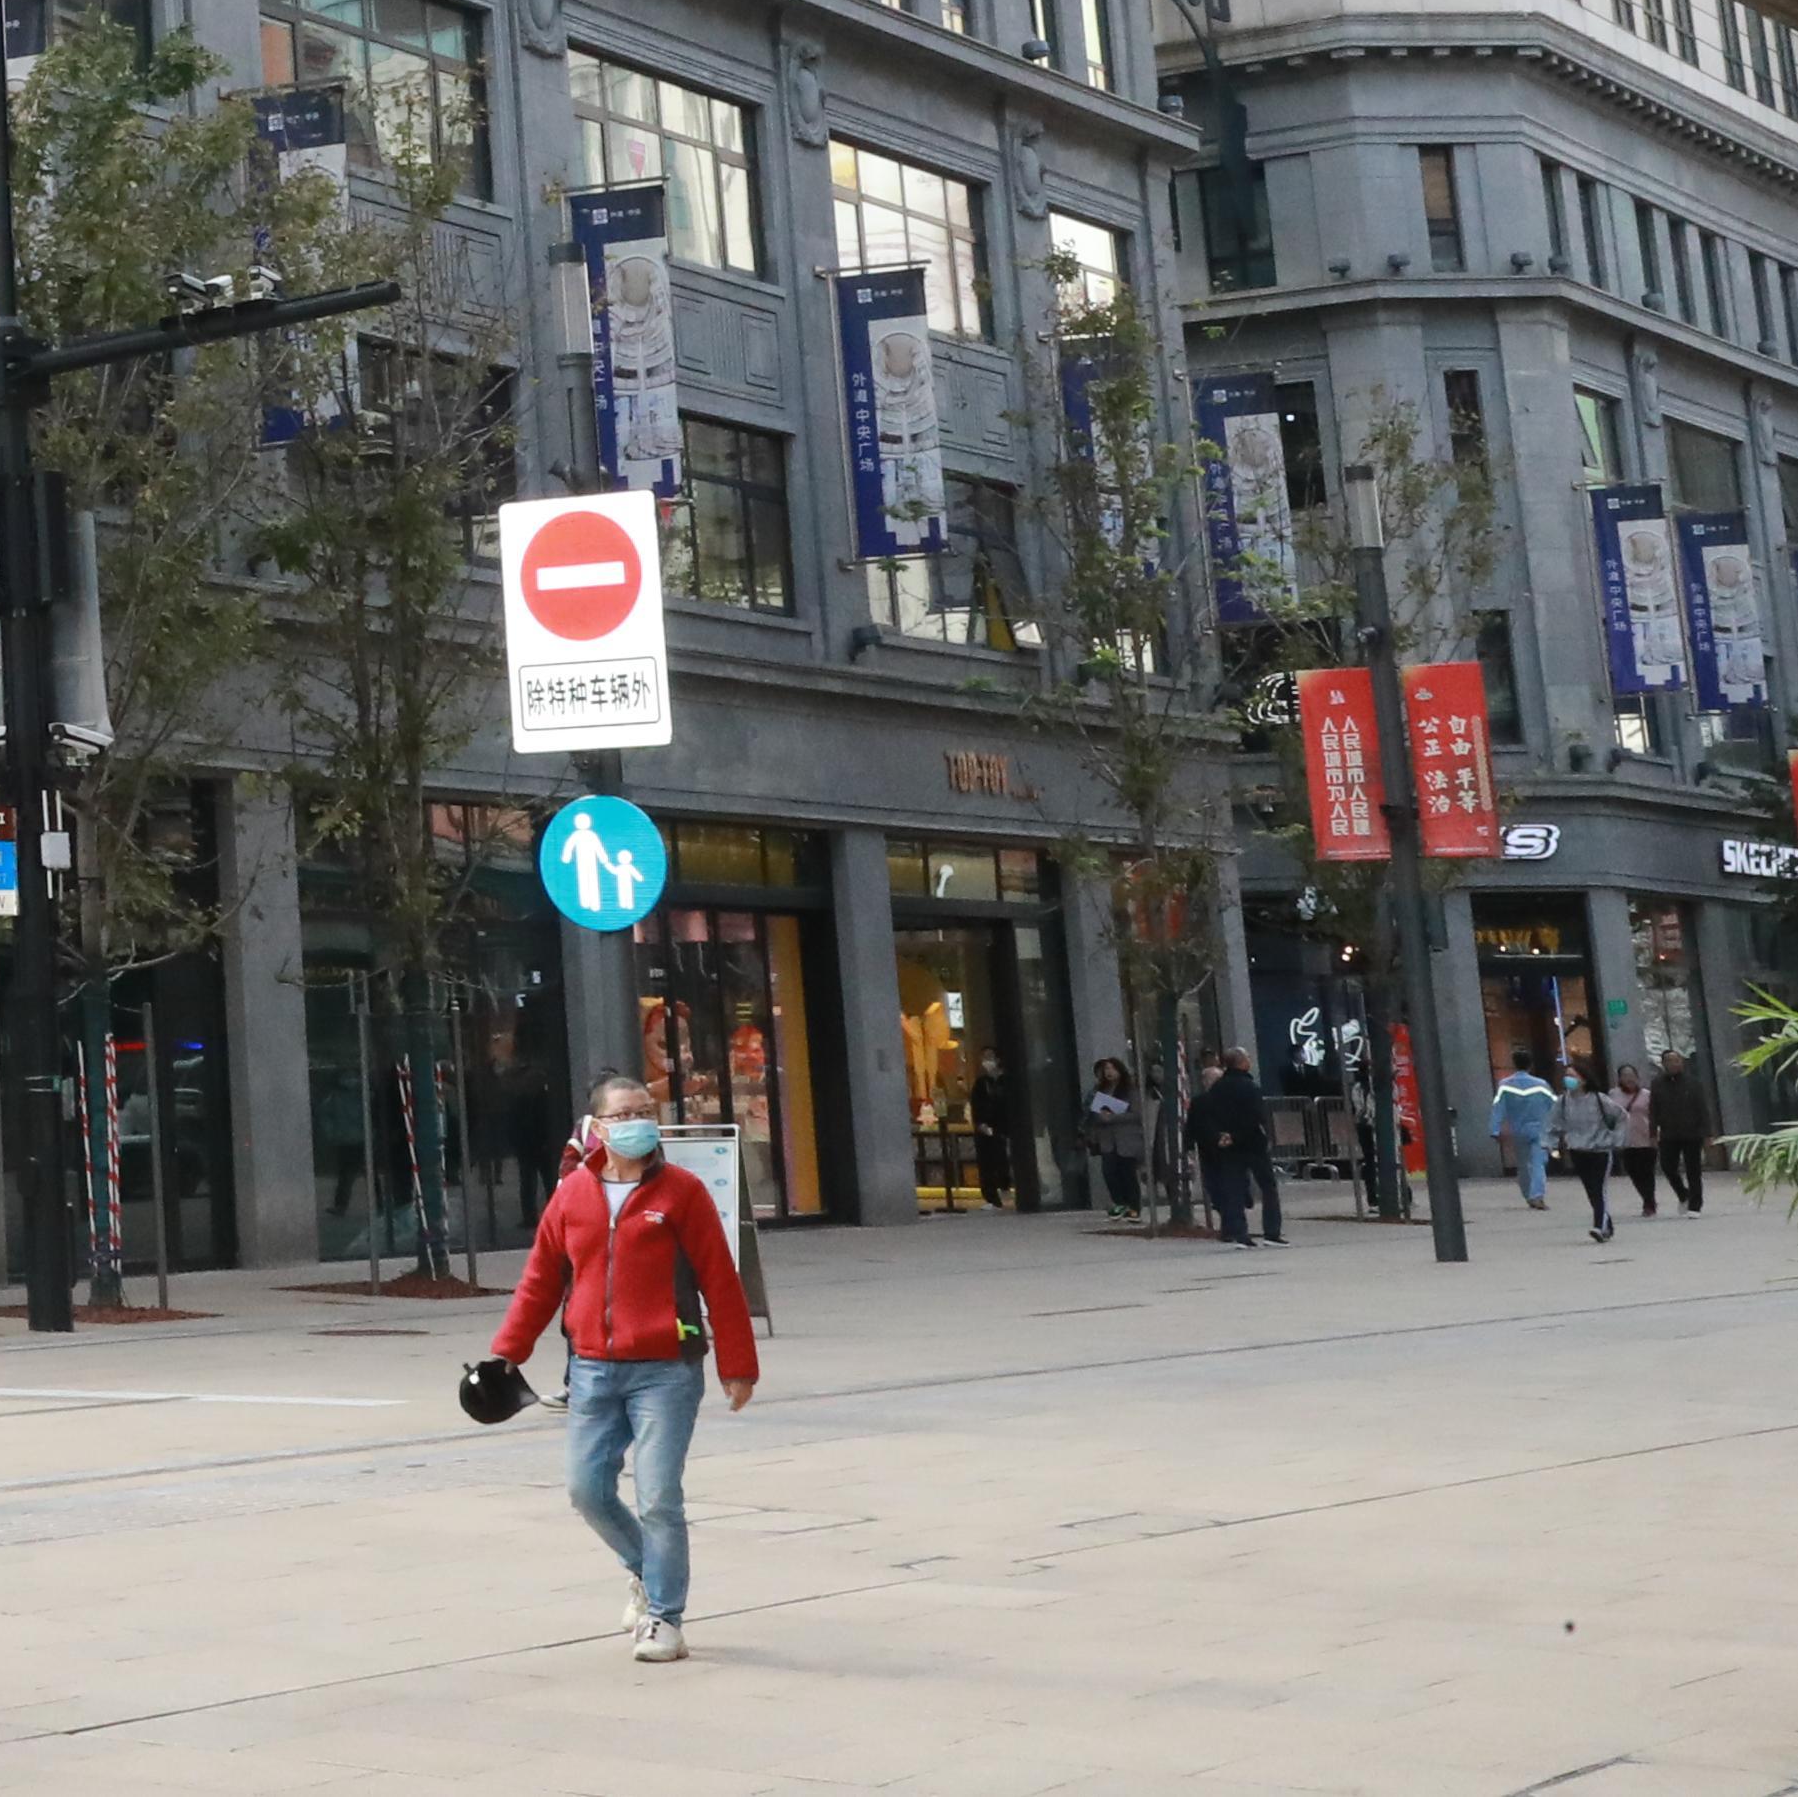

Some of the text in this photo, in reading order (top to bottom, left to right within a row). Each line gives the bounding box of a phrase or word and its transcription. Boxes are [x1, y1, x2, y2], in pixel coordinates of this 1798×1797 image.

[526, 670, 651, 716] 除特种车辆外
